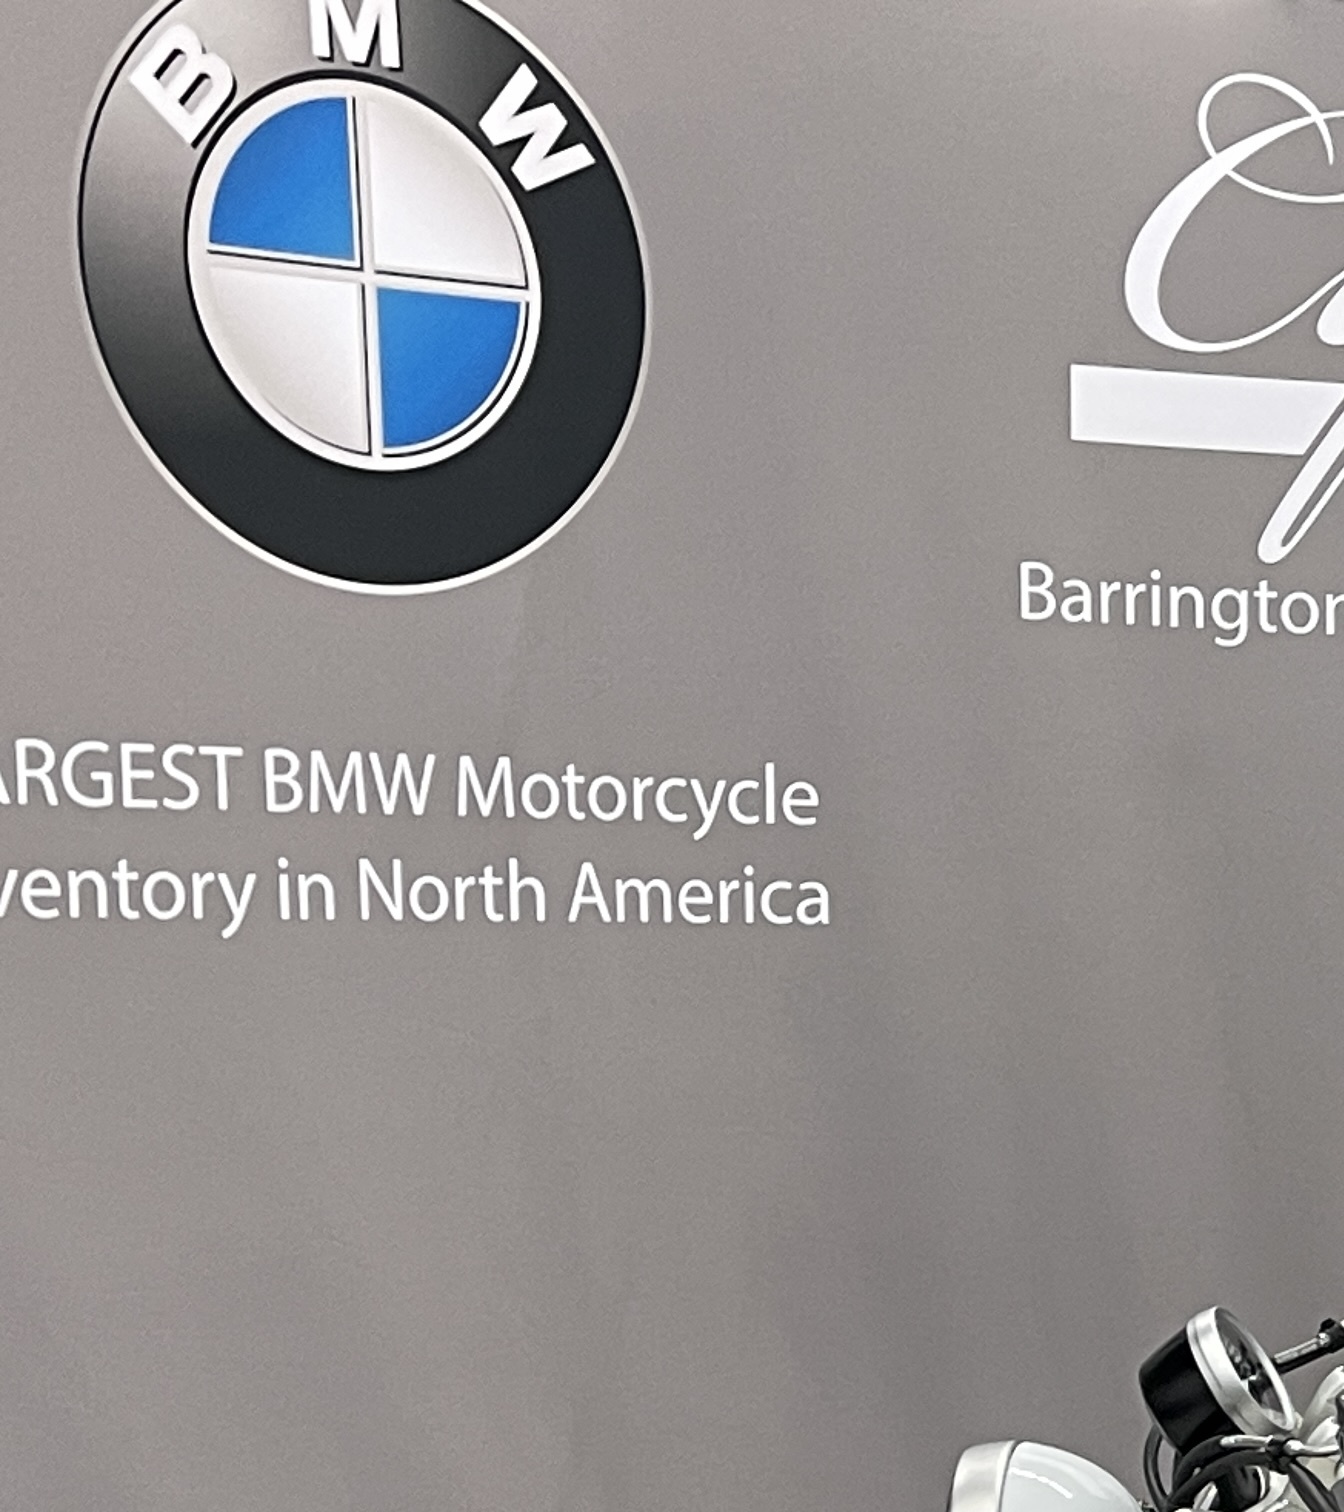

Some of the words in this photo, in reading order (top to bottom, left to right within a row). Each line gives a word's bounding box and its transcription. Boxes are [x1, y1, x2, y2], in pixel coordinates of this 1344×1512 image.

[129, 0, 597, 191] BMW
[0, 738, 244, 811] RGEST
[264, 747, 437, 817] BMW
[457, 755, 820, 841] Motorcycle
[277, 857, 336, 921] in
[358, 857, 547, 923] North
[568, 861, 831, 926] America
